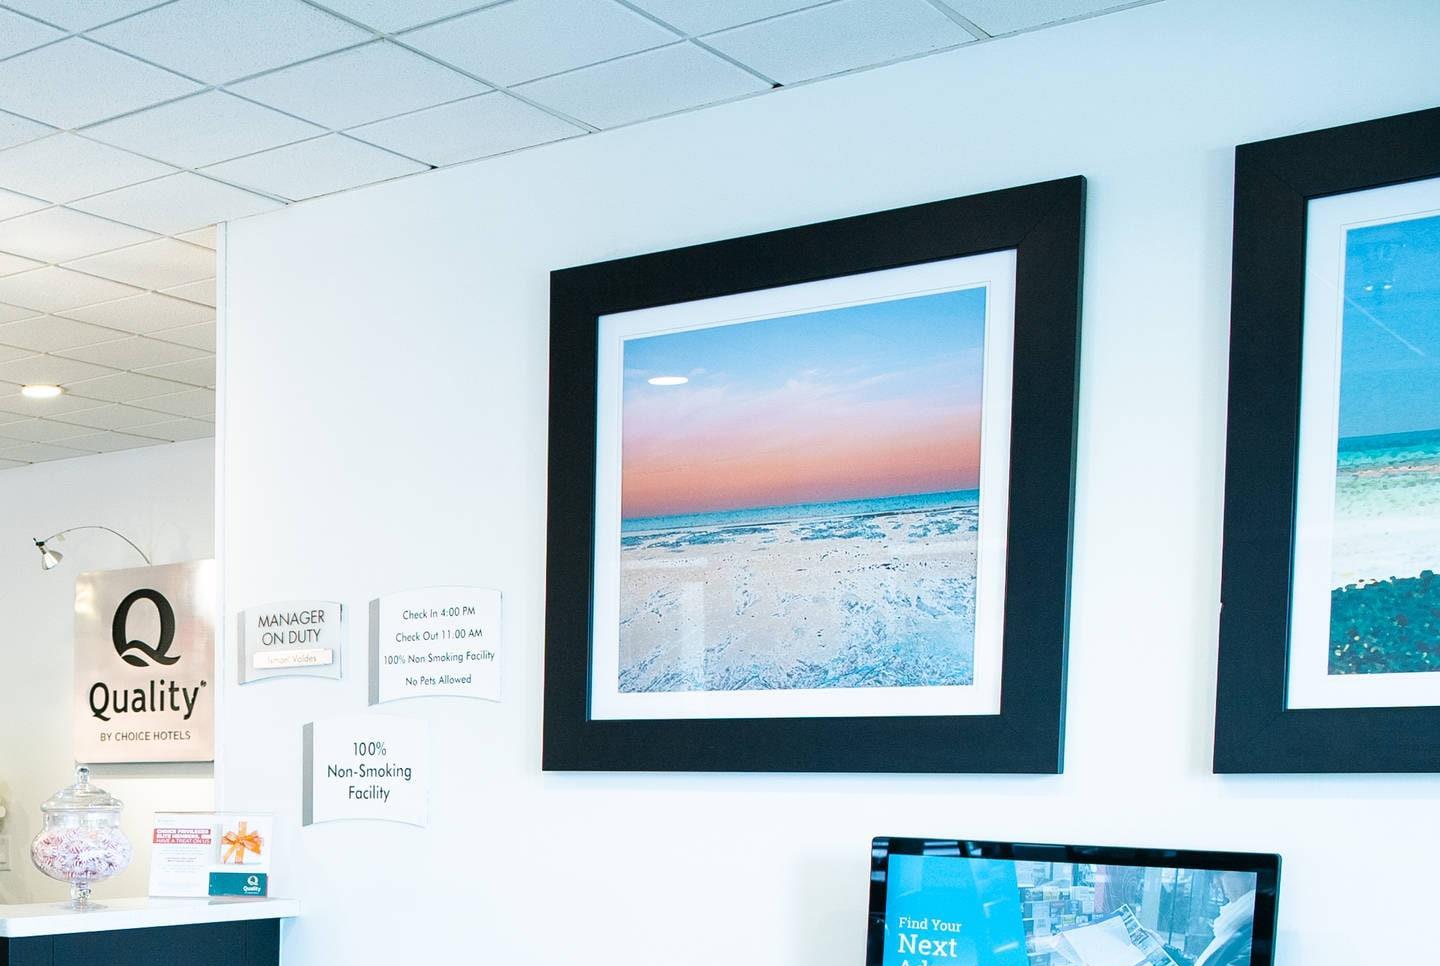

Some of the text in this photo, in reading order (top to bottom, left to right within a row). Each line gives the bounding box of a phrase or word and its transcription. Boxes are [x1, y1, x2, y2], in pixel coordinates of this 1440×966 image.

[258, 610, 325, 628] MANAGER
[403, 606, 476, 620] Check In 4:00 PM
[112, 589, 181, 667] Q
[396, 632, 420, 642] Check
[423, 631, 438, 640] Out
[468, 629, 482, 637] AM
[262, 629, 321, 646] ON DUTY
[384, 655, 405, 664] 100%
[466, 650, 495, 662] Facility
[405, 674, 471, 686] No Pets Allowed
[89, 680, 199, 721] Quality
[100, 731, 191, 742] BY CHOICE HOTELS
[354, 741, 386, 756] 100%
[328, 763, 412, 781] Non-Smoking
[349, 785, 390, 803] Facility
[899, 917, 962, 932] Find Your
[898, 934, 957, 957] Next
